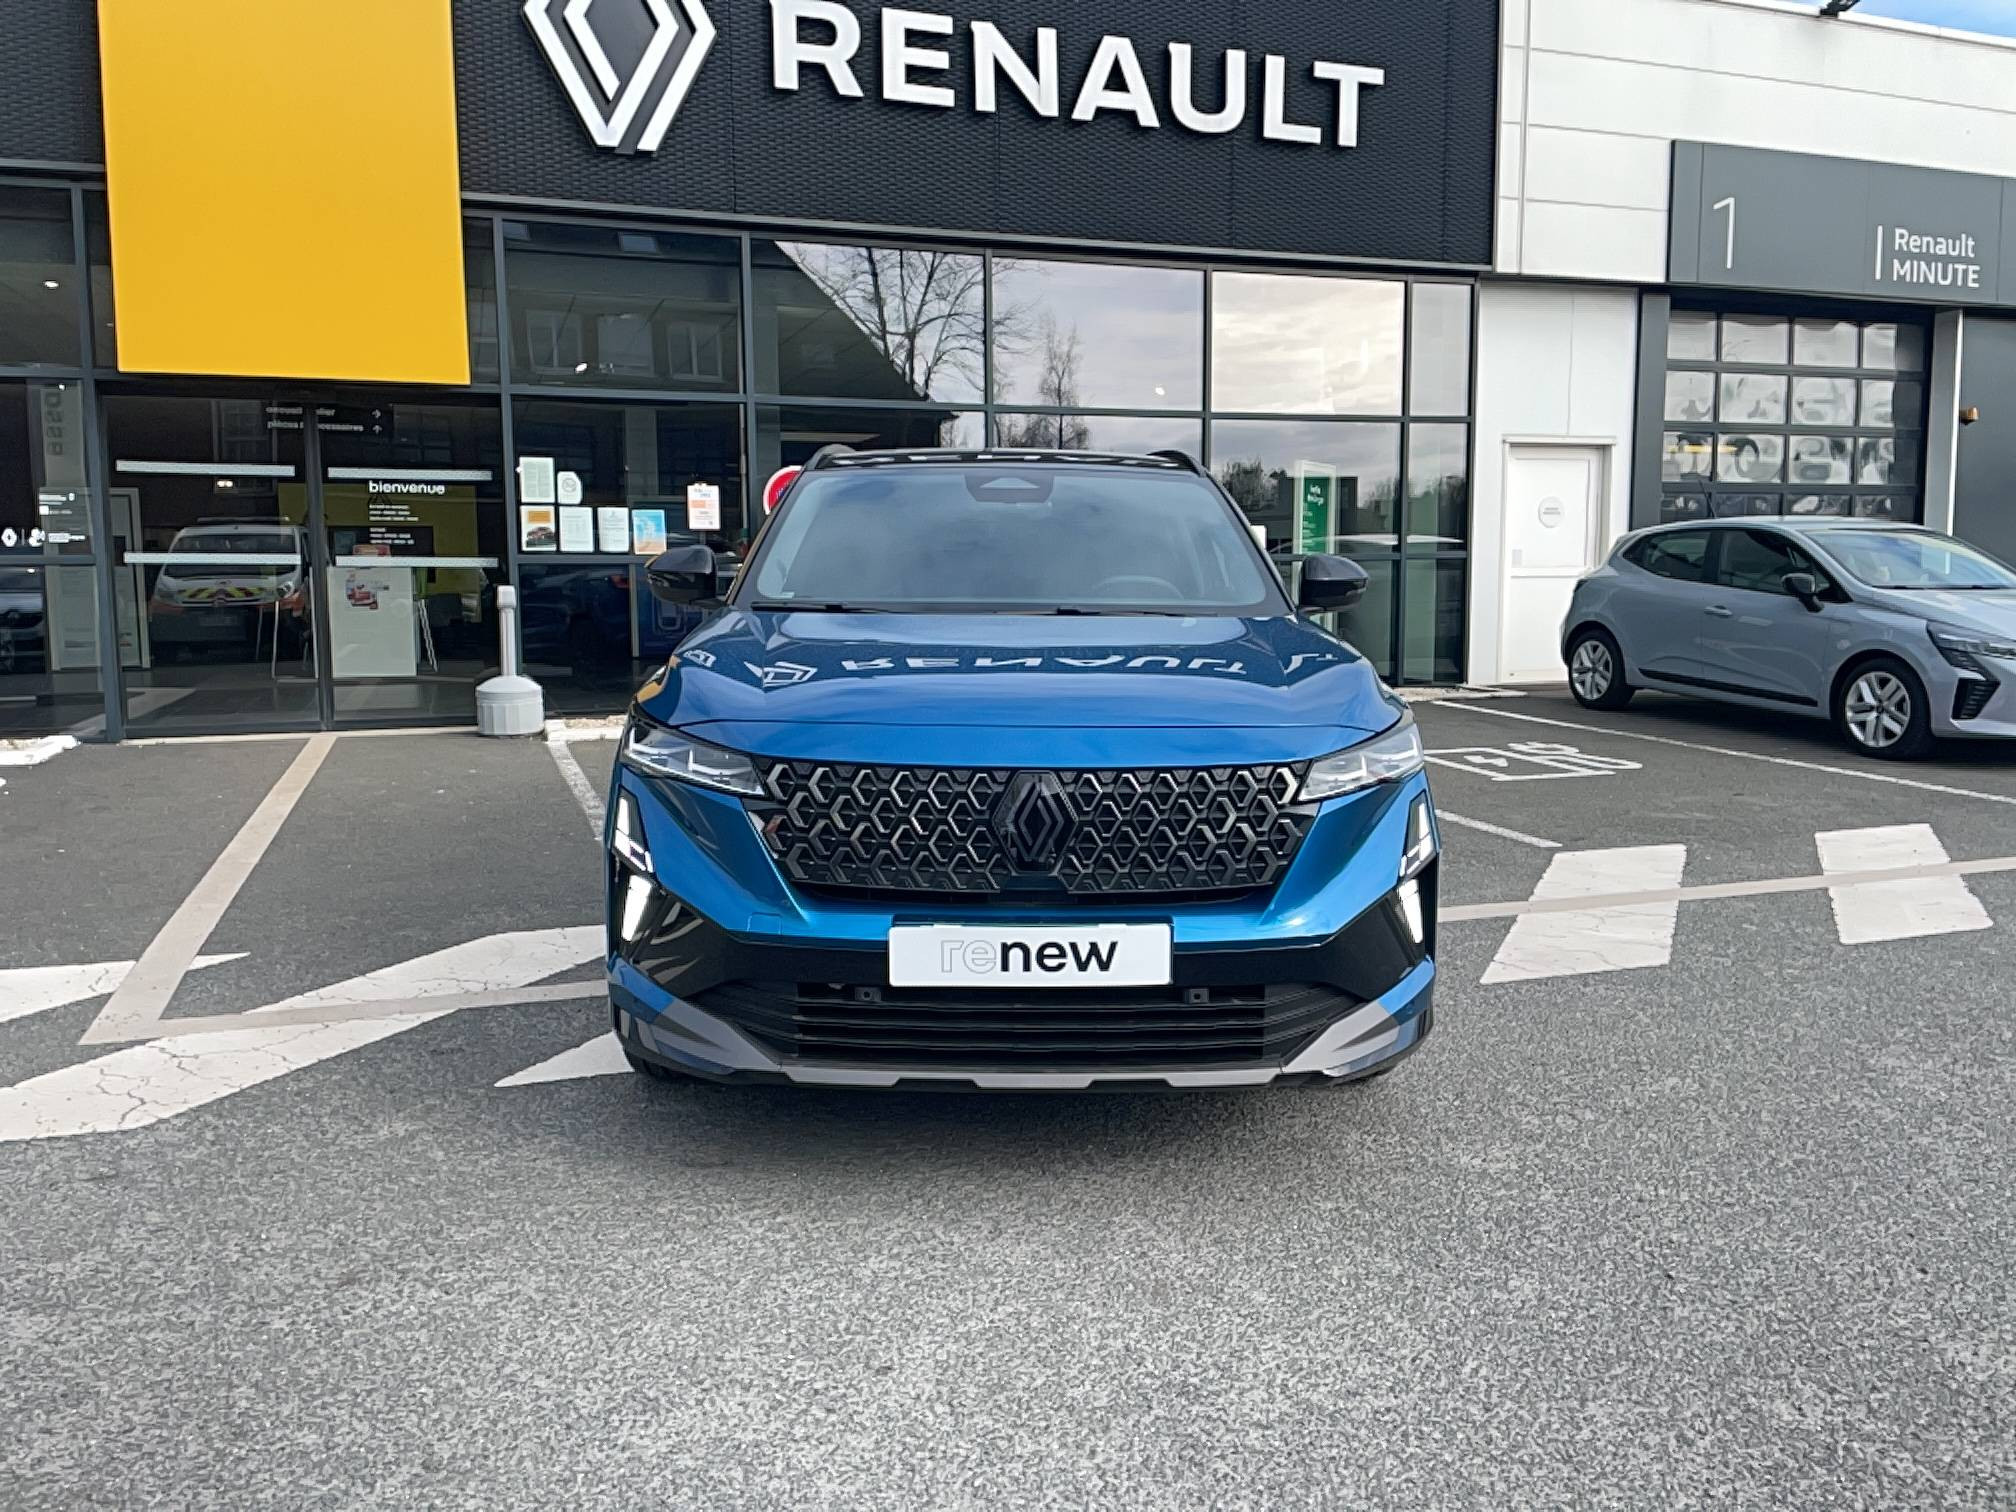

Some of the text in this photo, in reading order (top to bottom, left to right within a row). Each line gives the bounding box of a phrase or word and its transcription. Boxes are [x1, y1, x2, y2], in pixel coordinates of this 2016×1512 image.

[771, 0, 1386, 149] RENAULT
[1713, 197, 1736, 270] 1
[1894, 226, 1976, 259] Renault
[1891, 258, 1982, 289] MINUTE
[368, 480, 446, 495] bienvenue
[940, 939, 1119, 975] renew
